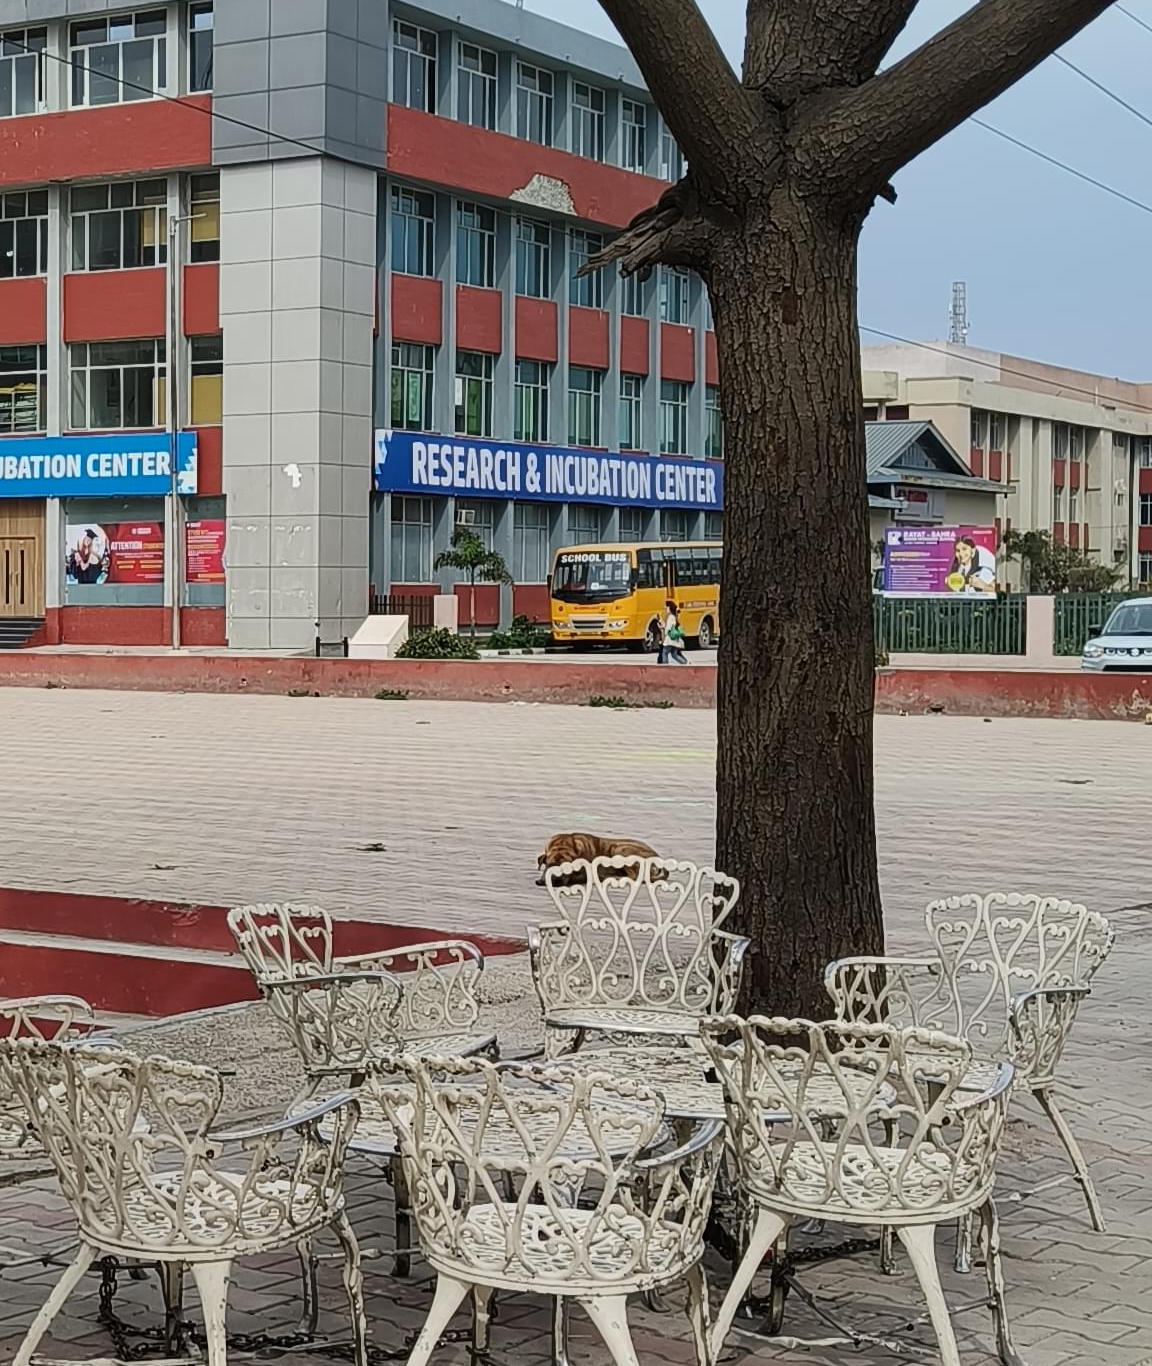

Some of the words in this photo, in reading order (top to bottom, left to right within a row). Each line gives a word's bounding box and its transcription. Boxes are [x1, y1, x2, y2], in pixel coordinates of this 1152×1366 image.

[86, 451, 171, 478] CENTER
[411, 441, 521, 491] RESEARCH
[525, 452, 541, 494] &
[545, 454, 651, 500] INCUBATION
[655, 463, 717, 504] CENTER
[561, 553, 602, 564] SCHOOL
[604, 553, 627, 562] BUS
